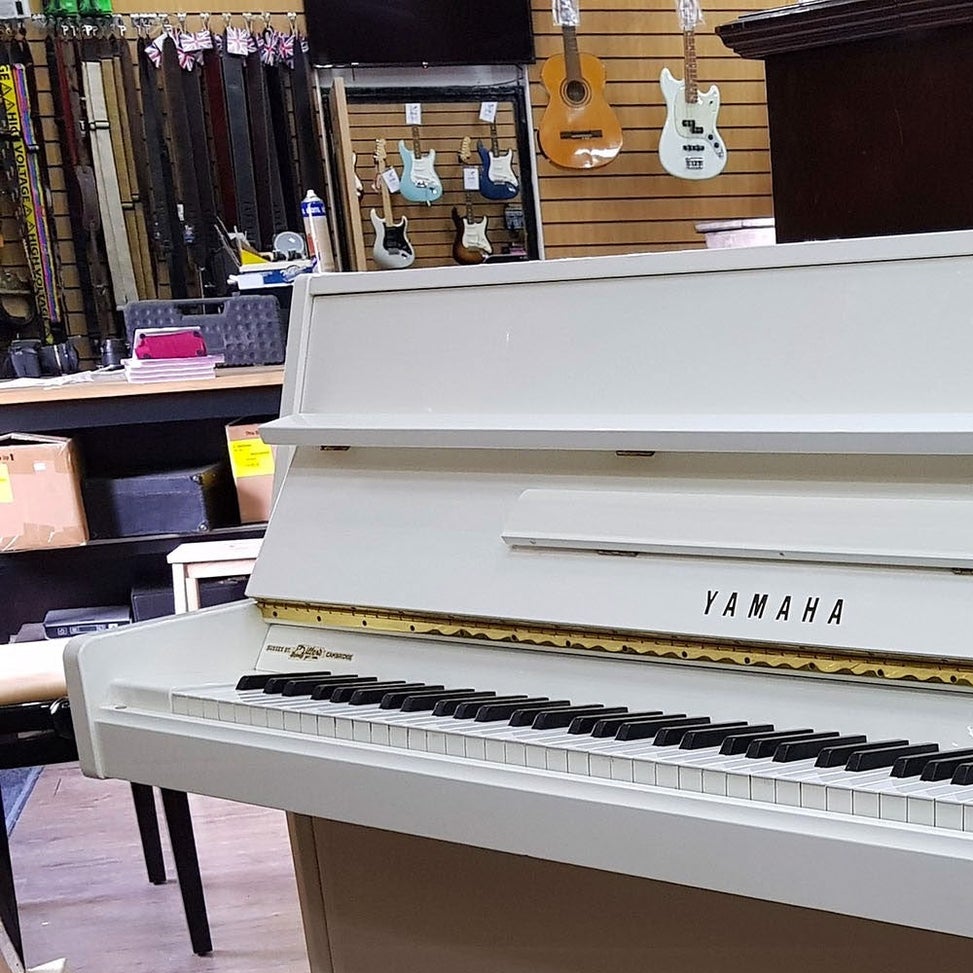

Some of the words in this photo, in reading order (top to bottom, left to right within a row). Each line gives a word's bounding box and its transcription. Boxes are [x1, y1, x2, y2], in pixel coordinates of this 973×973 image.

[14, 145, 31, 203] VOLTAGE
[28, 235, 41, 265] HIGH
[704, 590, 844, 625] YAMAHA
